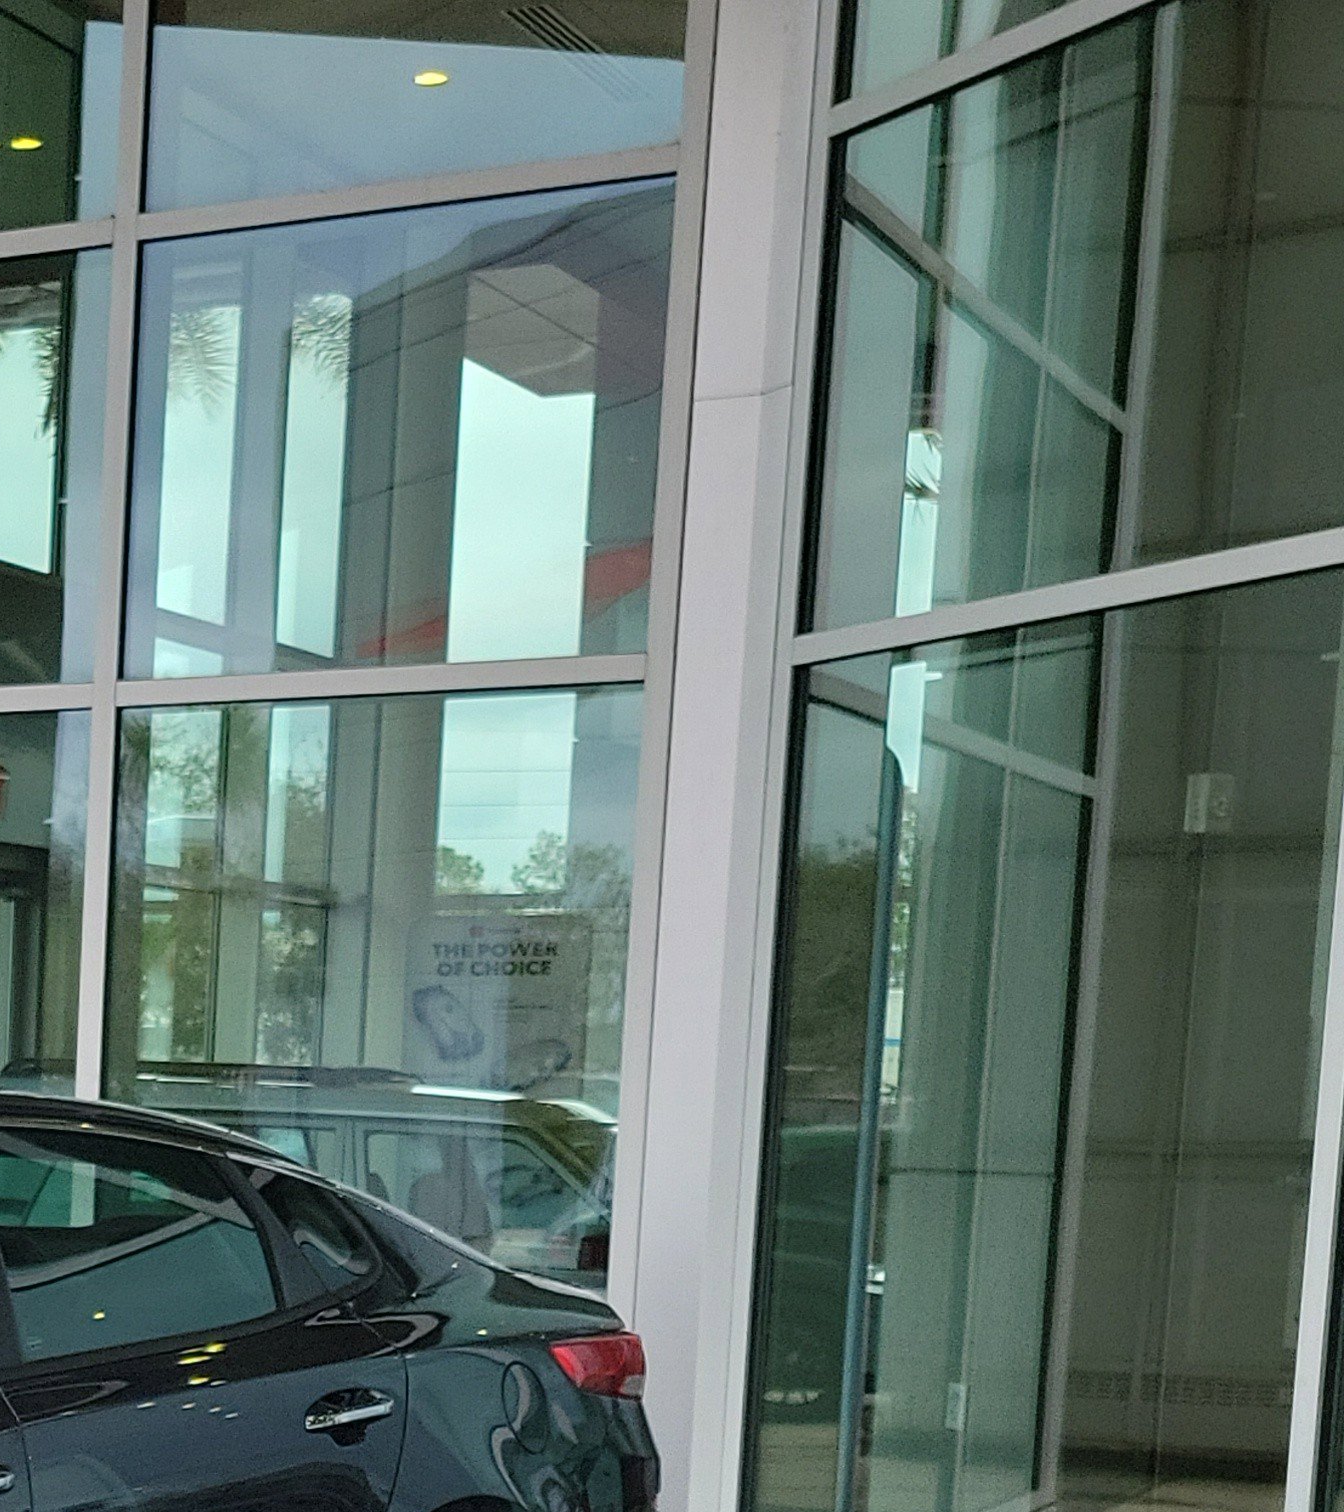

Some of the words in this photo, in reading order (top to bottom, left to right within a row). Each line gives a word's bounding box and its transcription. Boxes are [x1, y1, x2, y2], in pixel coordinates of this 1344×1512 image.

[433, 943, 472, 957] THE
[477, 941, 559, 957] POWER
[437, 962, 464, 977] OF
[471, 960, 552, 977] CHOICE
